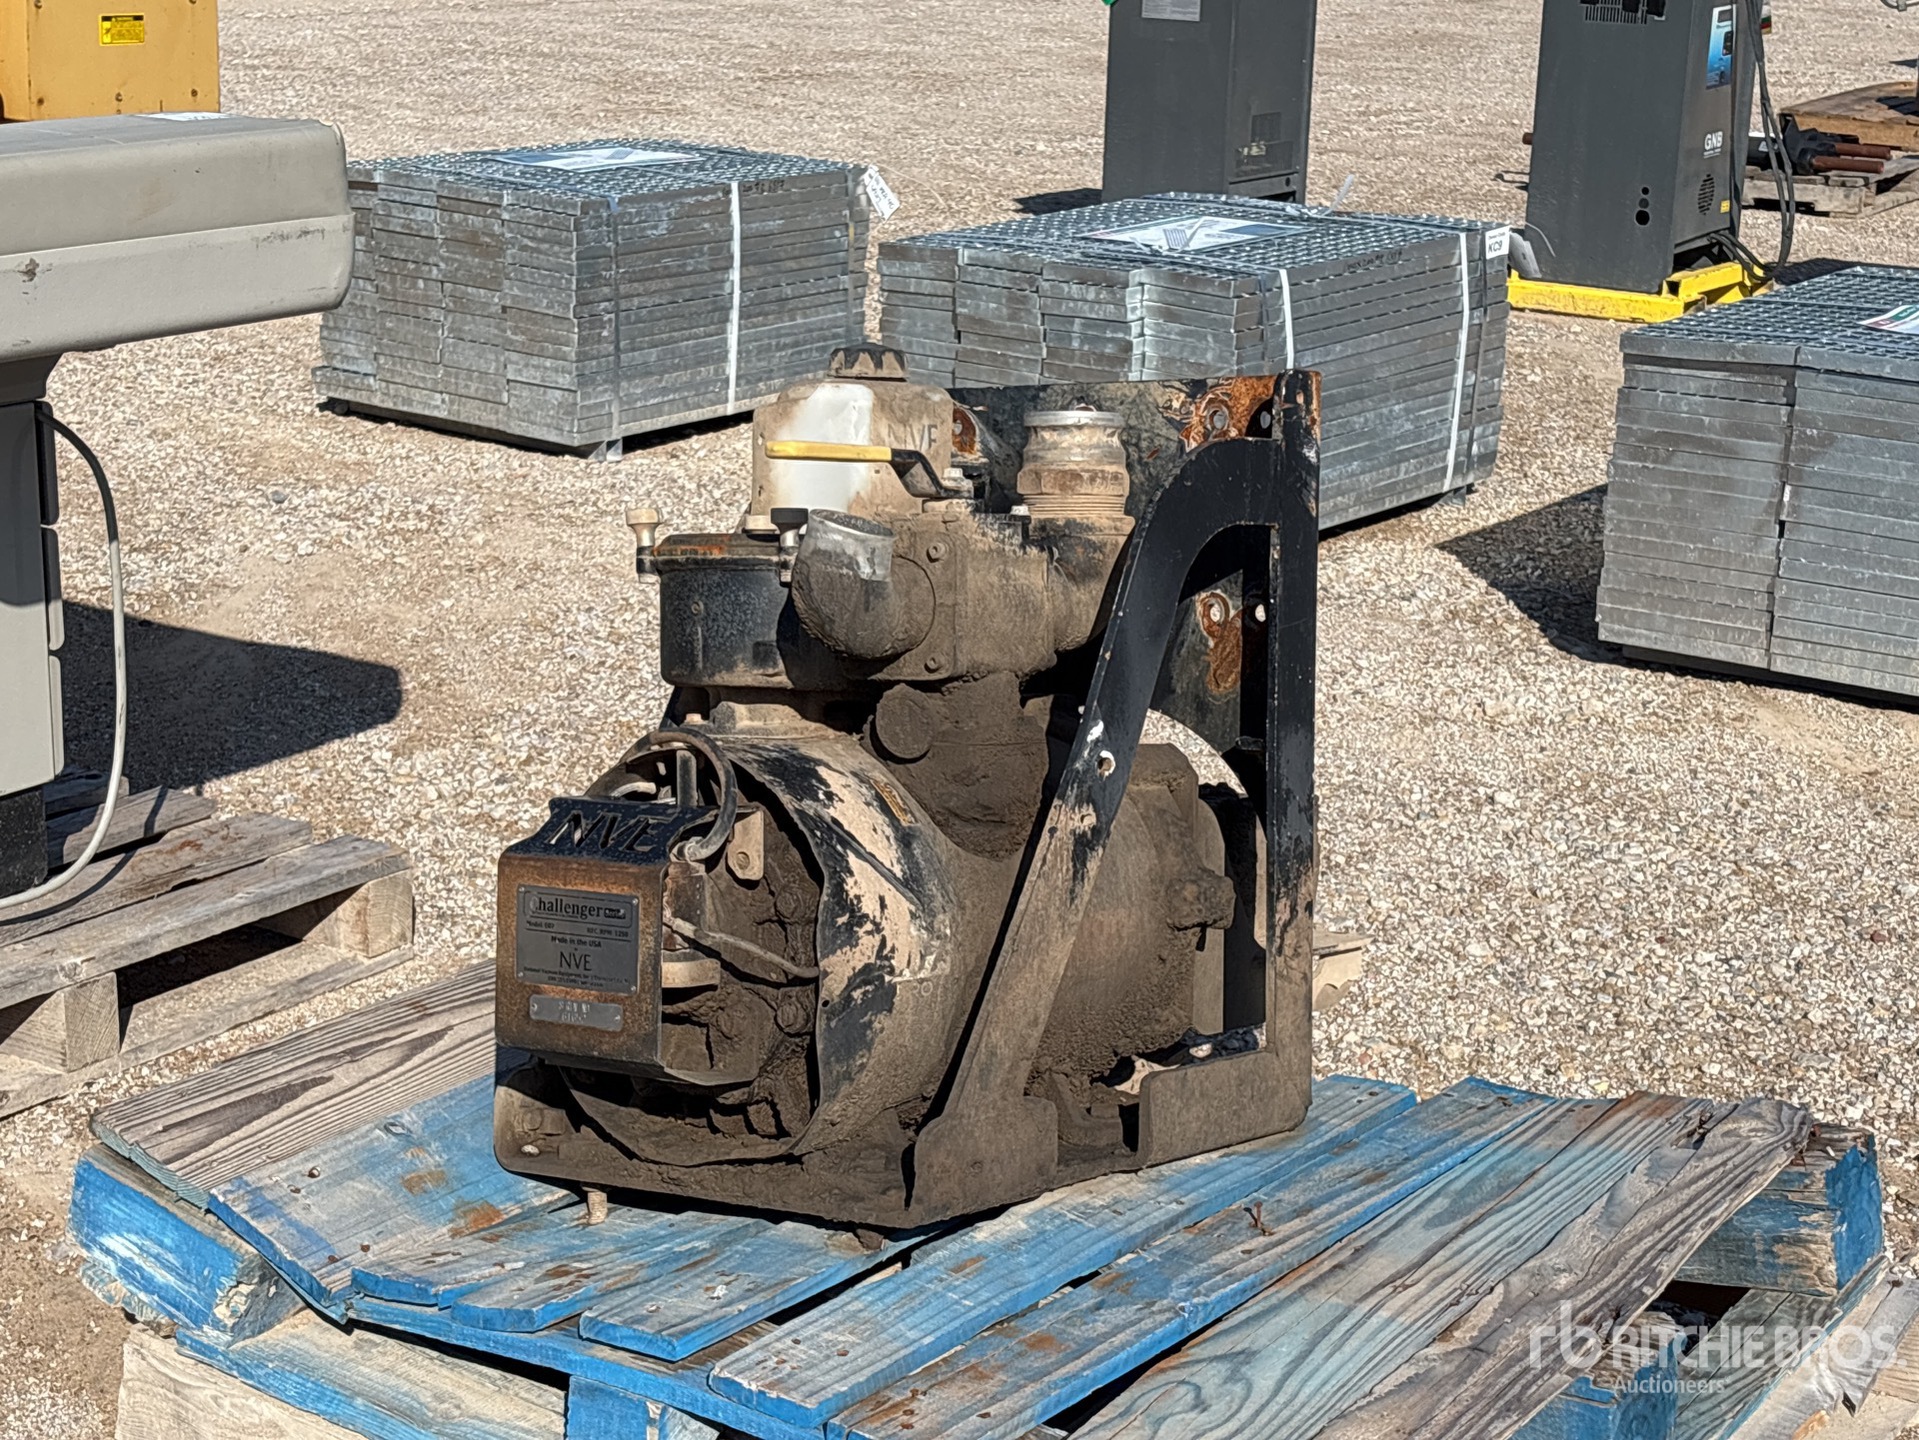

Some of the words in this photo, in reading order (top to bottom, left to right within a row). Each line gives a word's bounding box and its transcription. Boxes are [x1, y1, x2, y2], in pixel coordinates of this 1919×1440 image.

[1704, 131, 1723, 150] GNB
[544, 810, 678, 852] NVE
[589, 940, 602, 948] USA
[560, 951, 592, 971] NVE
